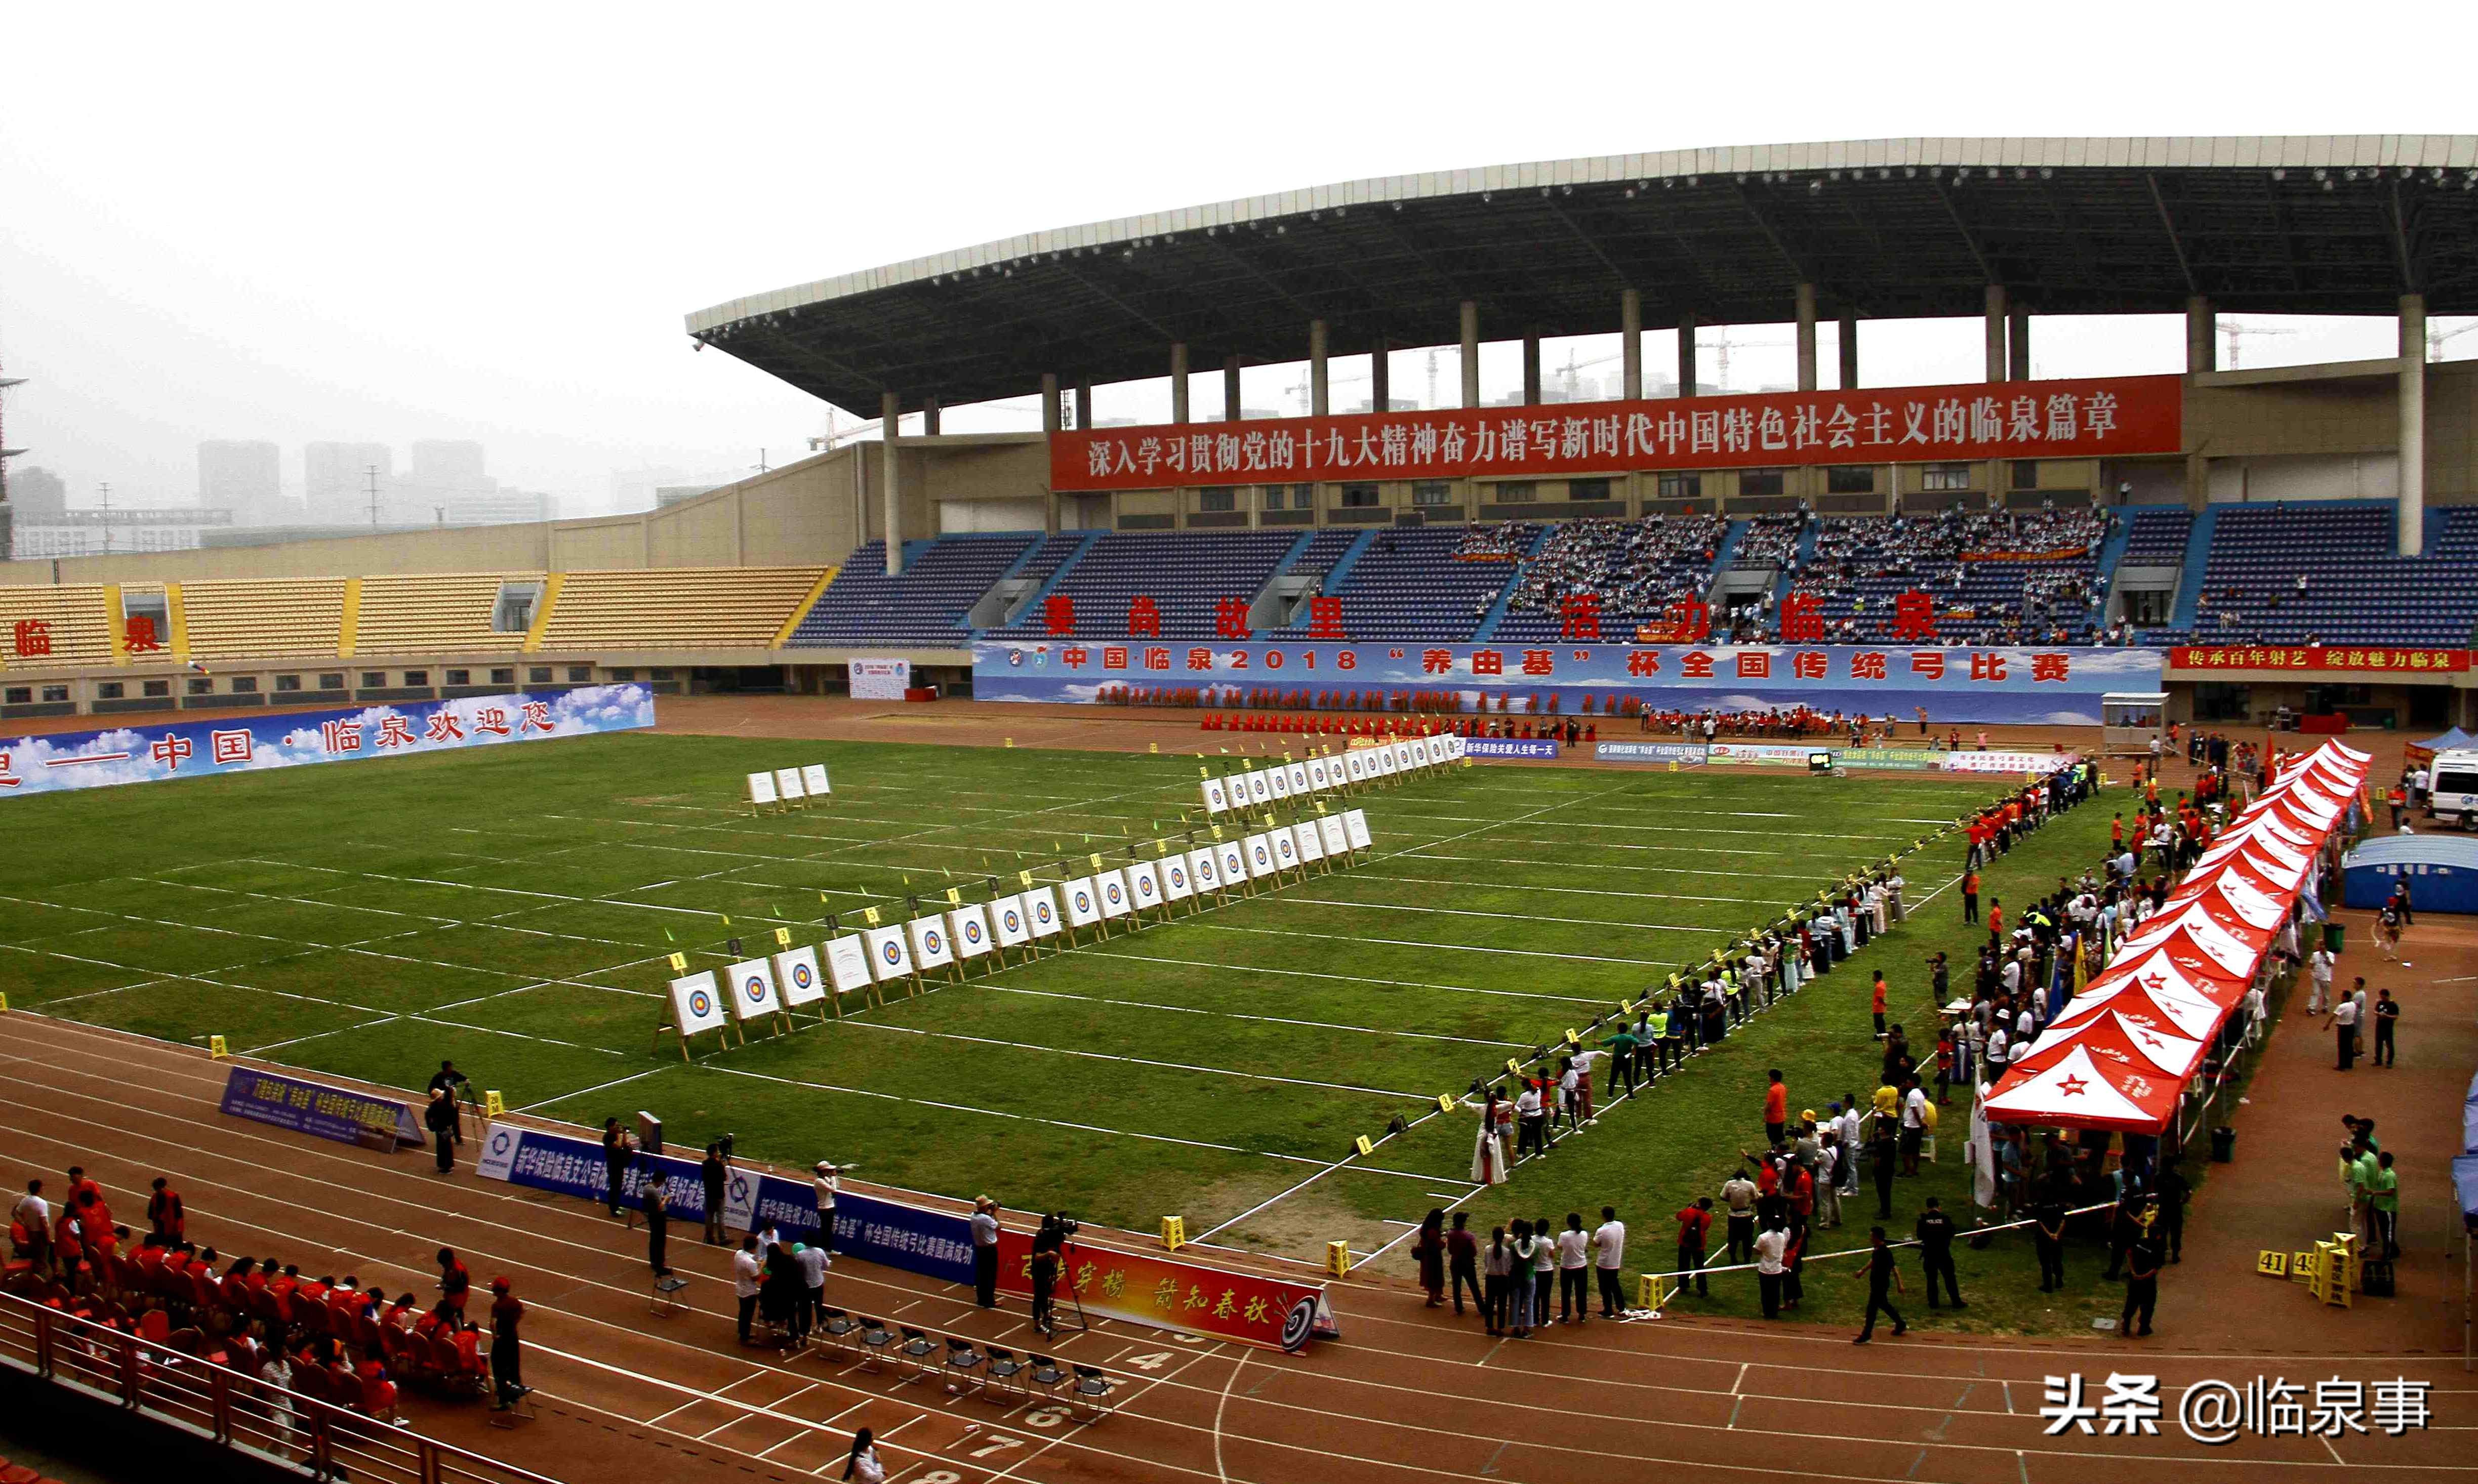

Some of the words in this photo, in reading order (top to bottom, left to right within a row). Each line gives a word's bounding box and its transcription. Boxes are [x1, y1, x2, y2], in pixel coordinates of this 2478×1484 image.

[1088, 391, 2119, 476] 深入学习贯彻党的十九大精神奋力谱写新时代中国特色社会主义的临泉篇章
[1043, 594, 1345, 639] 姜尚故里
[1561, 587, 1939, 641] 活力临泉
[14, 614, 159, 656] 临泉
[2188, 649, 2308, 666] 传承百年射艺
[2325, 650, 2450, 669] 绽放魅力临泉
[1466, 742, 1553, 756] 新华保险关爱人生每一天
[2260, 1252, 2282, 1271] 41
[1125, 1351, 1175, 1369] 4
[968, 1434, 1026, 1458] 7
